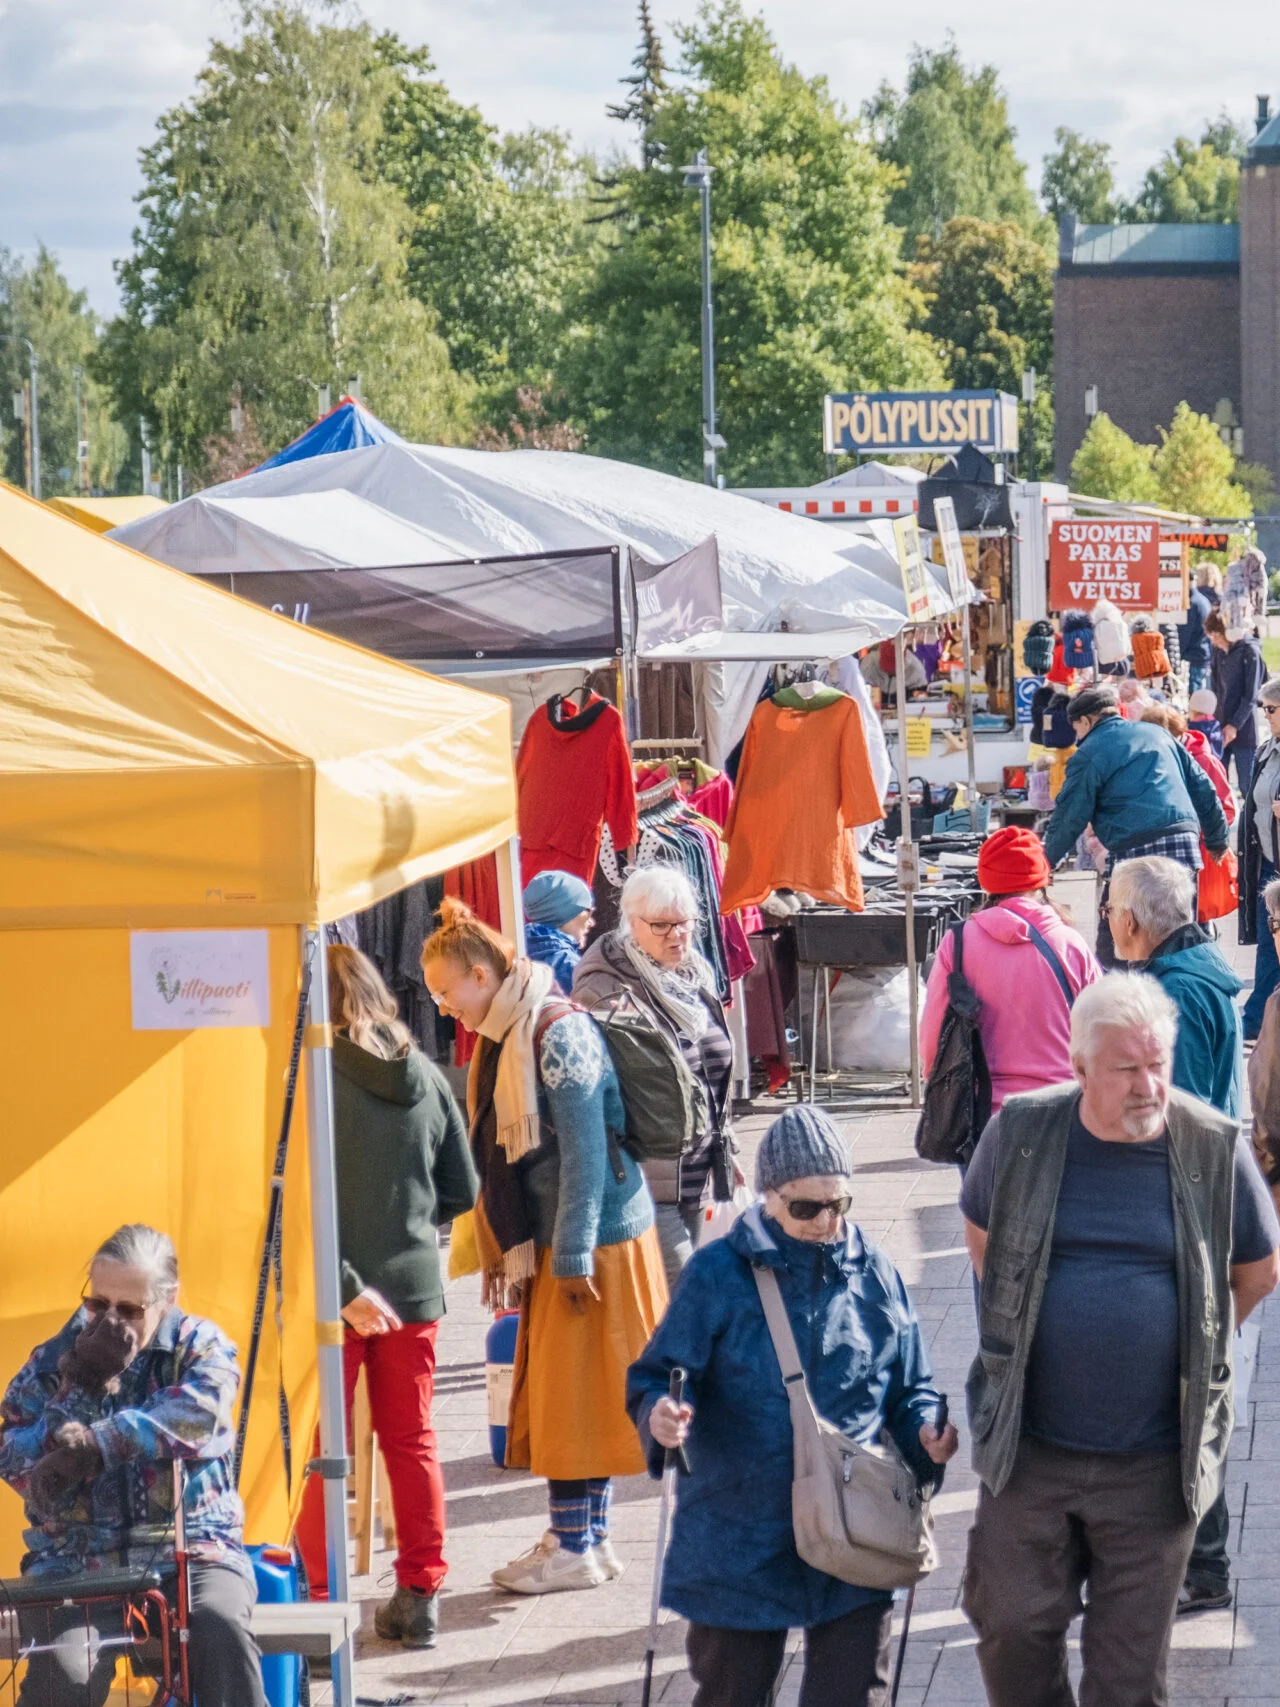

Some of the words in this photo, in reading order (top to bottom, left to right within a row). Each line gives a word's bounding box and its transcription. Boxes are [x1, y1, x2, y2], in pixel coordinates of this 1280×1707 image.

[833, 396, 992, 444] PÖLYPUSSIT
[1058, 524, 1152, 543] SUOMEN
[1069, 543, 1142, 562] PARAS
[1082, 562, 1128, 581] FILE
[1068, 581, 1141, 600] VEITSI
